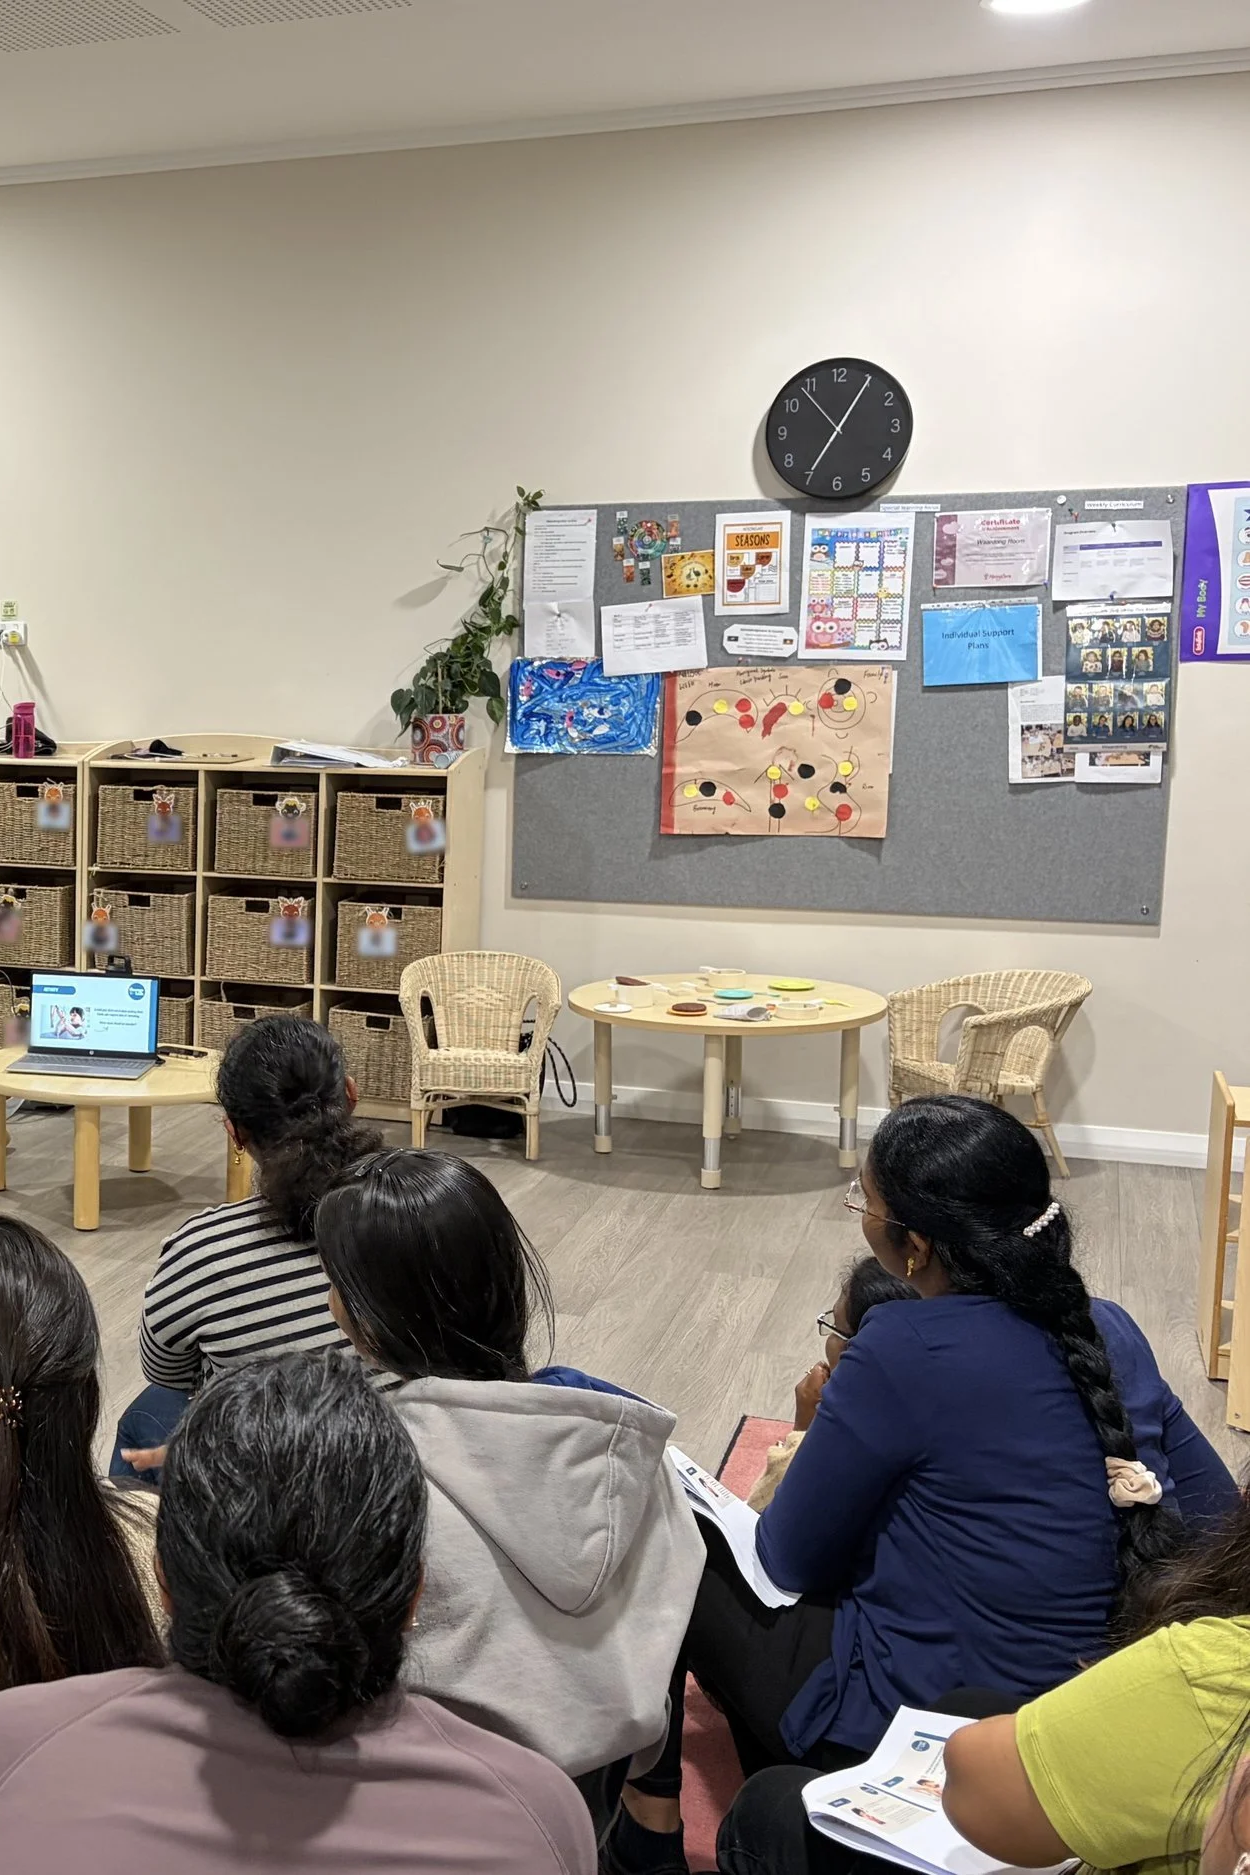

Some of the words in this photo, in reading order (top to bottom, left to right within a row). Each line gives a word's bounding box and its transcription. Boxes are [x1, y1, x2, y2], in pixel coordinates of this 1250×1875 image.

[831, 367, 847, 382] 12
[805, 377, 816, 392] 11
[783, 398, 799, 413] 10
[884, 391, 894, 406] 2
[777, 426, 788, 440] 9
[890, 418, 901, 433] 3
[783, 453, 794, 468] 8
[882, 447, 892, 461] 4
[804, 471, 814, 485] 7
[861, 467, 871, 482] 5
[832, 476, 842, 491] 6
[981, 518, 1020, 526] Certificate
[735, 533, 771, 547] SEASONS
[942, 631, 981, 640] Individual
[982, 629, 1014, 639] Support
[967, 642, 989, 650] Plans
